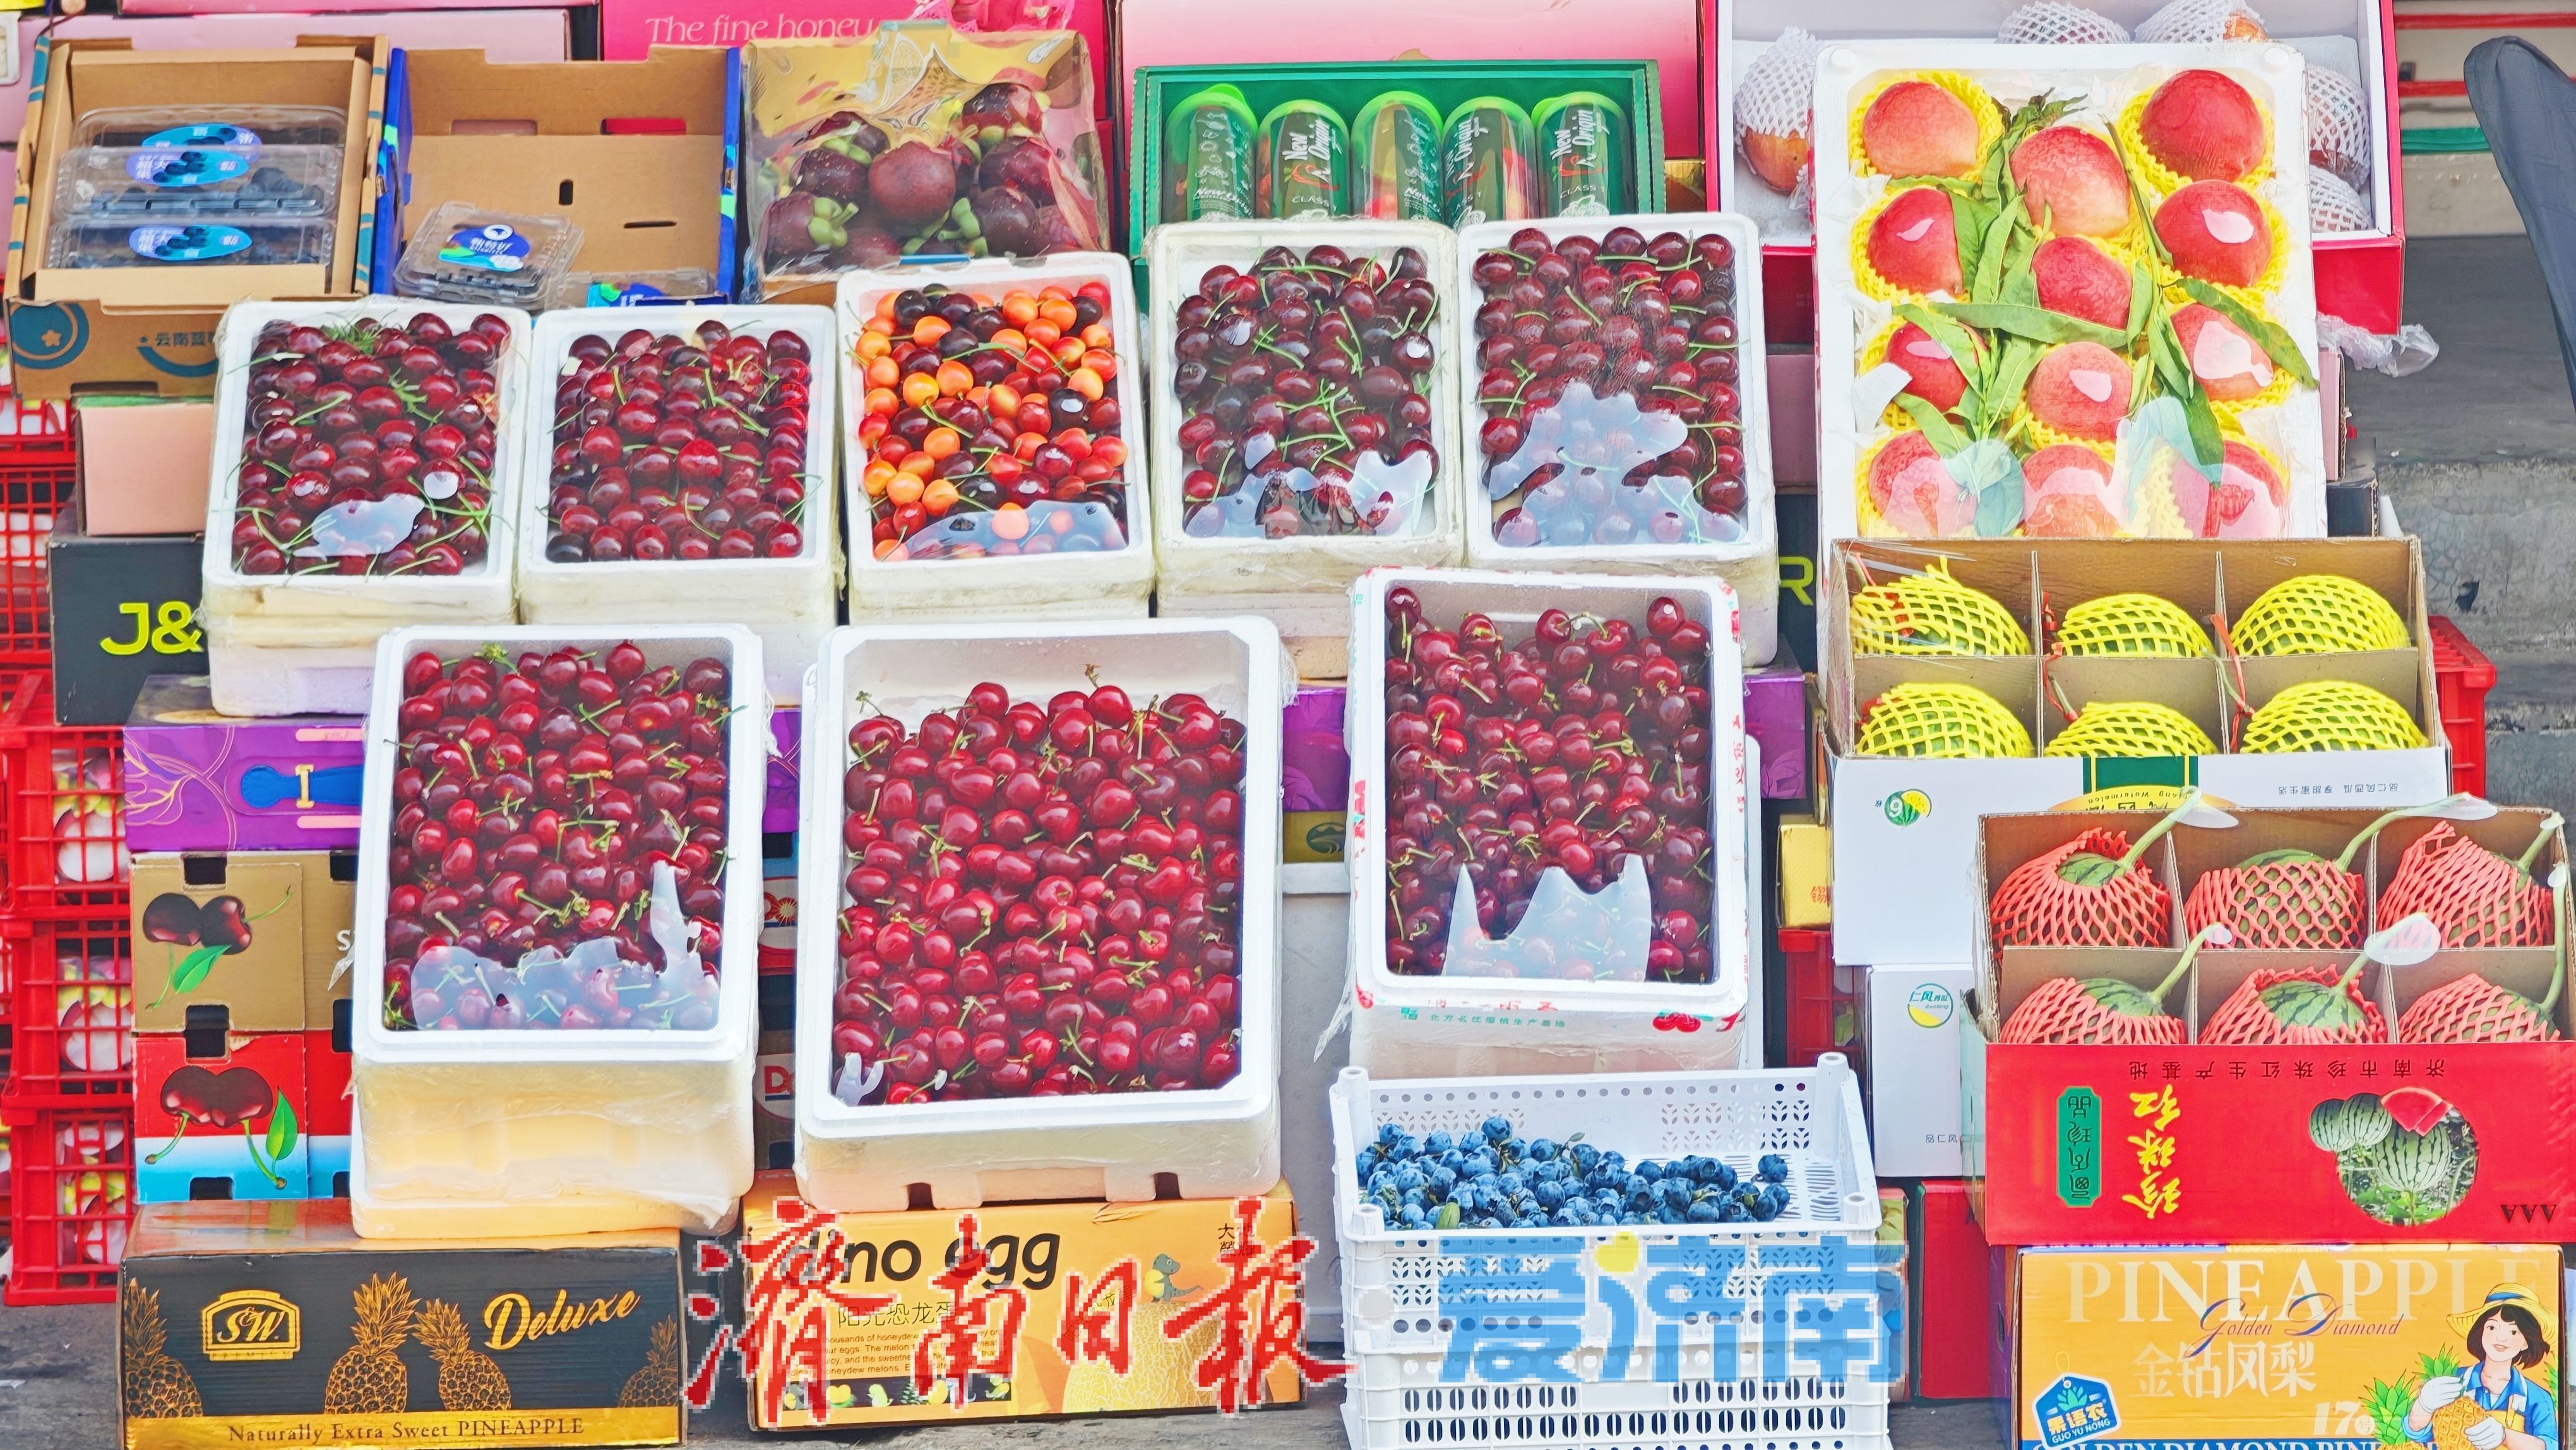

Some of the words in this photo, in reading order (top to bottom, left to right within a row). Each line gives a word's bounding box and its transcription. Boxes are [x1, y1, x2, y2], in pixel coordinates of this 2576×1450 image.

[646, 16, 704, 42] The
[712, 14, 768, 45] fine
[1308, 118, 1332, 160] Origin
[1571, 110, 1596, 145] Origin
[1282, 131, 1308, 161] New
[1550, 129, 1572, 160] New
[1292, 196, 1330, 207] CLASS
[1559, 184, 1597, 199] CLASS
[100, 601, 203, 655] J&
[2088, 791, 2149, 803] Watermelon
[2128, 1058, 2447, 1080] 济南市珍珠红生产基地
[1925, 1134, 1958, 1144] 品仁风
[2122, 1084, 2183, 1219] 珍珠红
[779, 1228, 922, 1286] dino
[945, 1232, 1061, 1291] egg
[484, 1288, 641, 1350] Deluxe
[838, 1301, 960, 1329] 阳光恐龙蛋
[2182, 1298, 2273, 1358] Golden
[2284, 1292, 2405, 1336] Diamond
[865, 1345, 881, 1353] The
[884, 1343, 909, 1351] melon
[877, 1332, 919, 1343] honeydew
[845, 1355, 861, 1363] and
[862, 1354, 876, 1362] the
[2131, 1339, 2317, 1399] 金钻凤梨
[228, 1422, 323, 1446] Naturally
[331, 1422, 384, 1439] Extra
[391, 1421, 449, 1439] Sweet
[456, 1417, 585, 1437] PINEAPPLE
[2047, 1402, 2108, 1435] 果语农
[2052, 1432, 2072, 1443] GUO
[2072, 1426, 2084, 1437] YU
[2085, 1418, 2111, 1432] NONG
